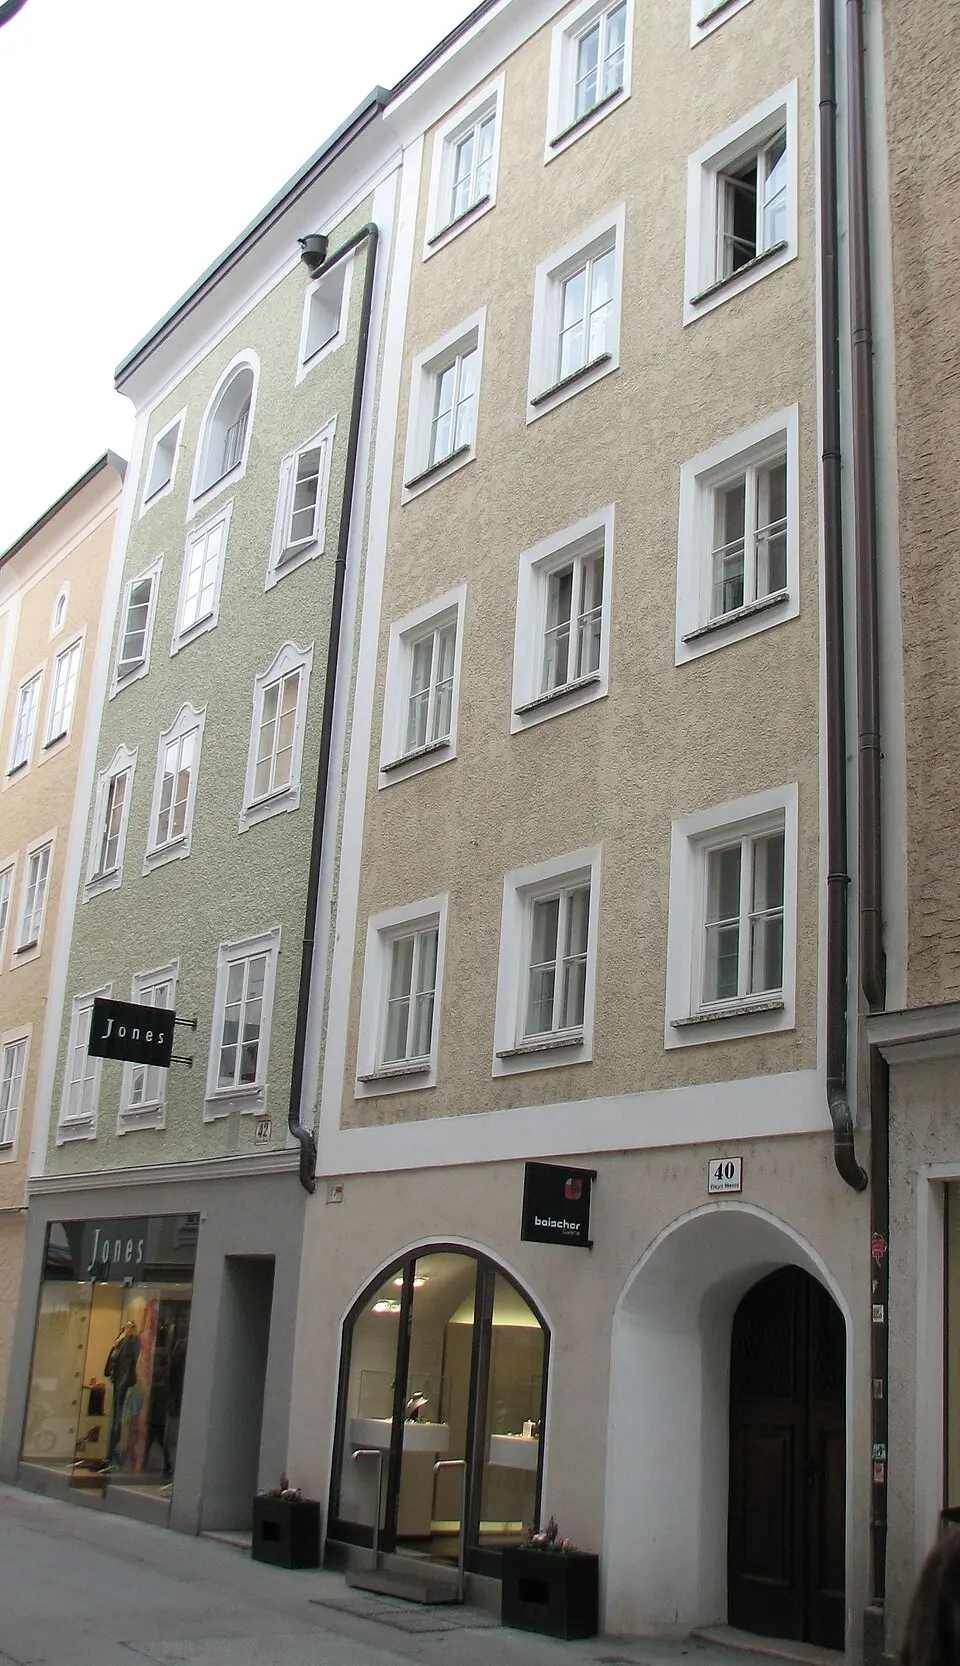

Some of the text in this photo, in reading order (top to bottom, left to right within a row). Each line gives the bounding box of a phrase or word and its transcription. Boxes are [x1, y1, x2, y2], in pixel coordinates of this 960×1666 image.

[101, 1018, 165, 1044] Jones
[714, 1161, 735, 1180] 40
[87, 1229, 144, 1271] Jones
